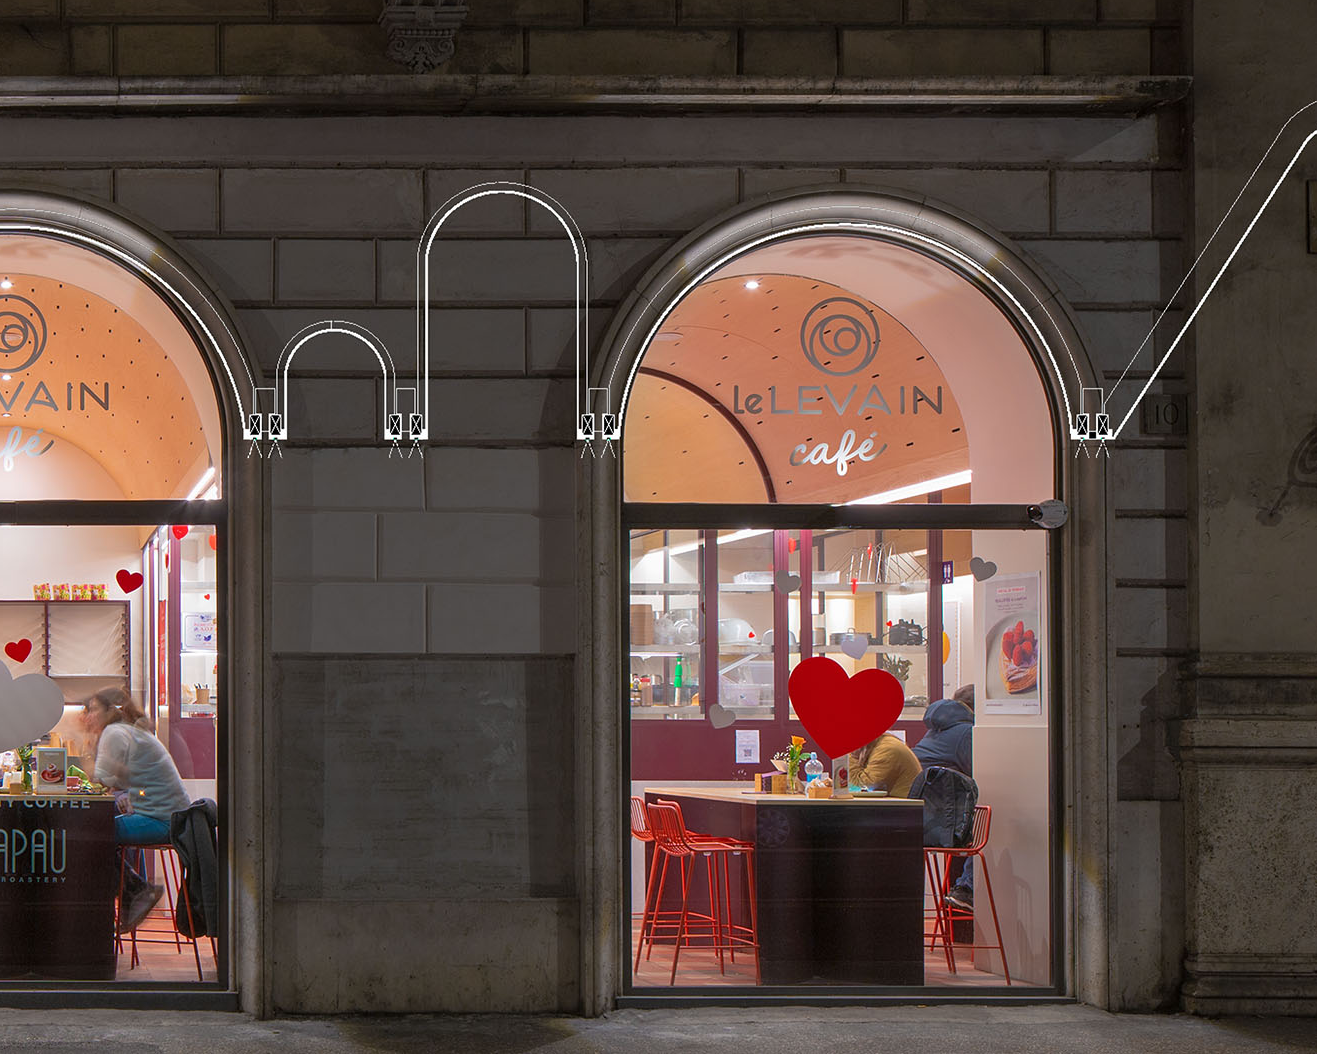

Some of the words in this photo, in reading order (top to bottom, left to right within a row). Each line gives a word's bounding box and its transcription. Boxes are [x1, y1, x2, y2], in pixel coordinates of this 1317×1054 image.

[1155, 402, 1179, 425] 10
[789, 429, 888, 476] café
[23, 798, 91, 809] COFFEE
